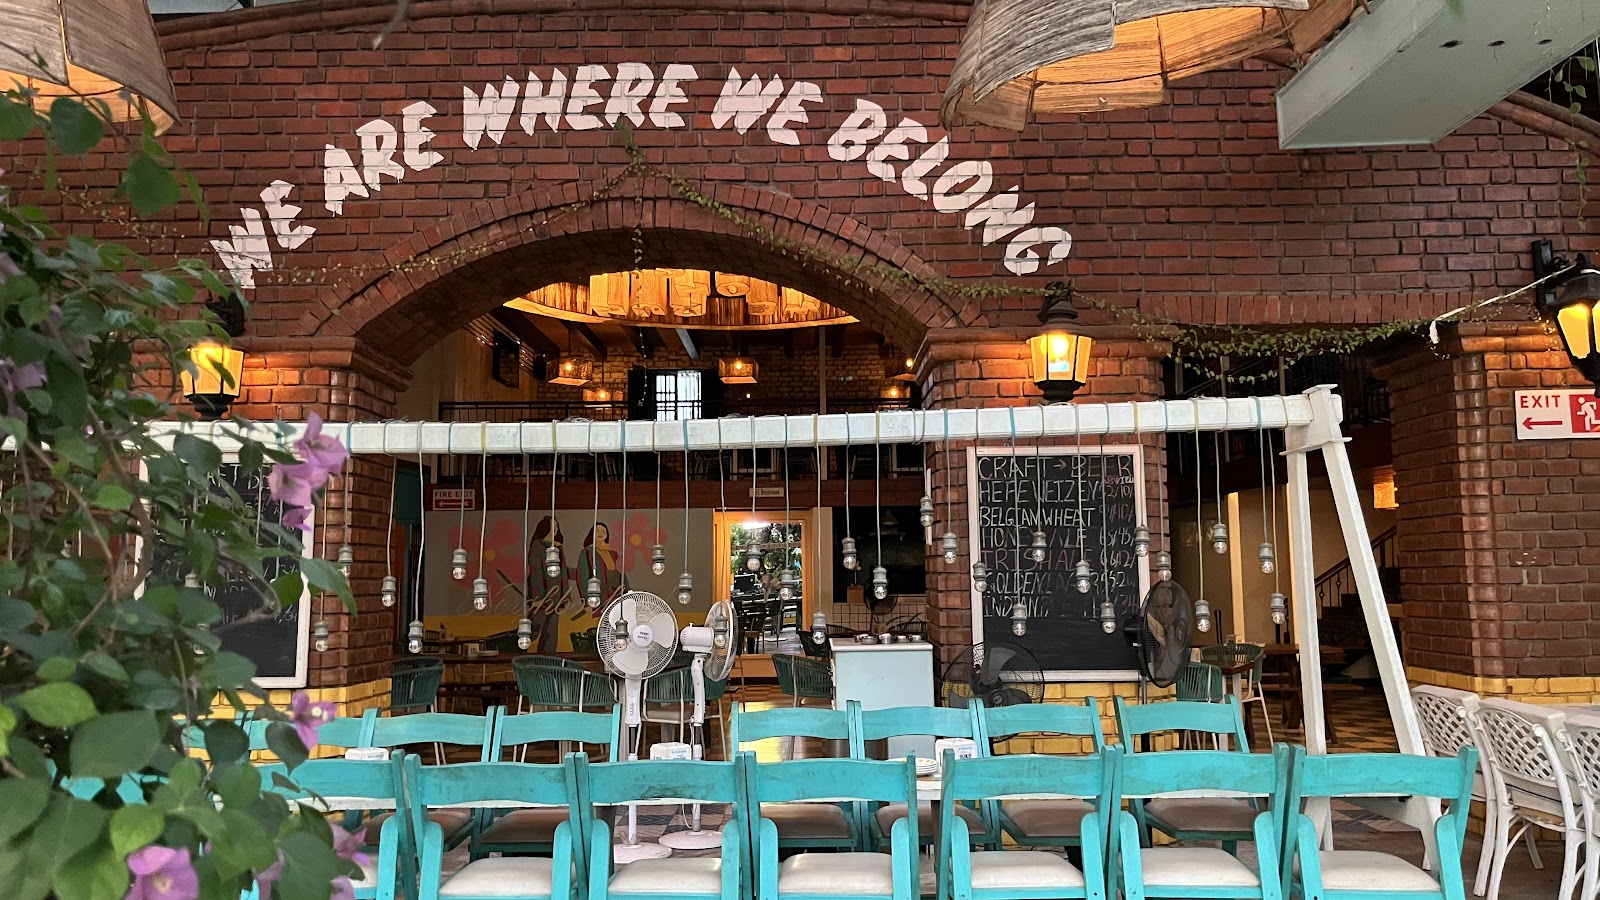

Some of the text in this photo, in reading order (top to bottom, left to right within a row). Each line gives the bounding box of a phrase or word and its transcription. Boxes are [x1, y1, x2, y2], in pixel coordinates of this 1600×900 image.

[209, 62, 1072, 289] WE ARE WHERE WE BELONG
[1520, 395, 1561, 408] EXIT
[978, 455, 1132, 479] CRAFT BEER
